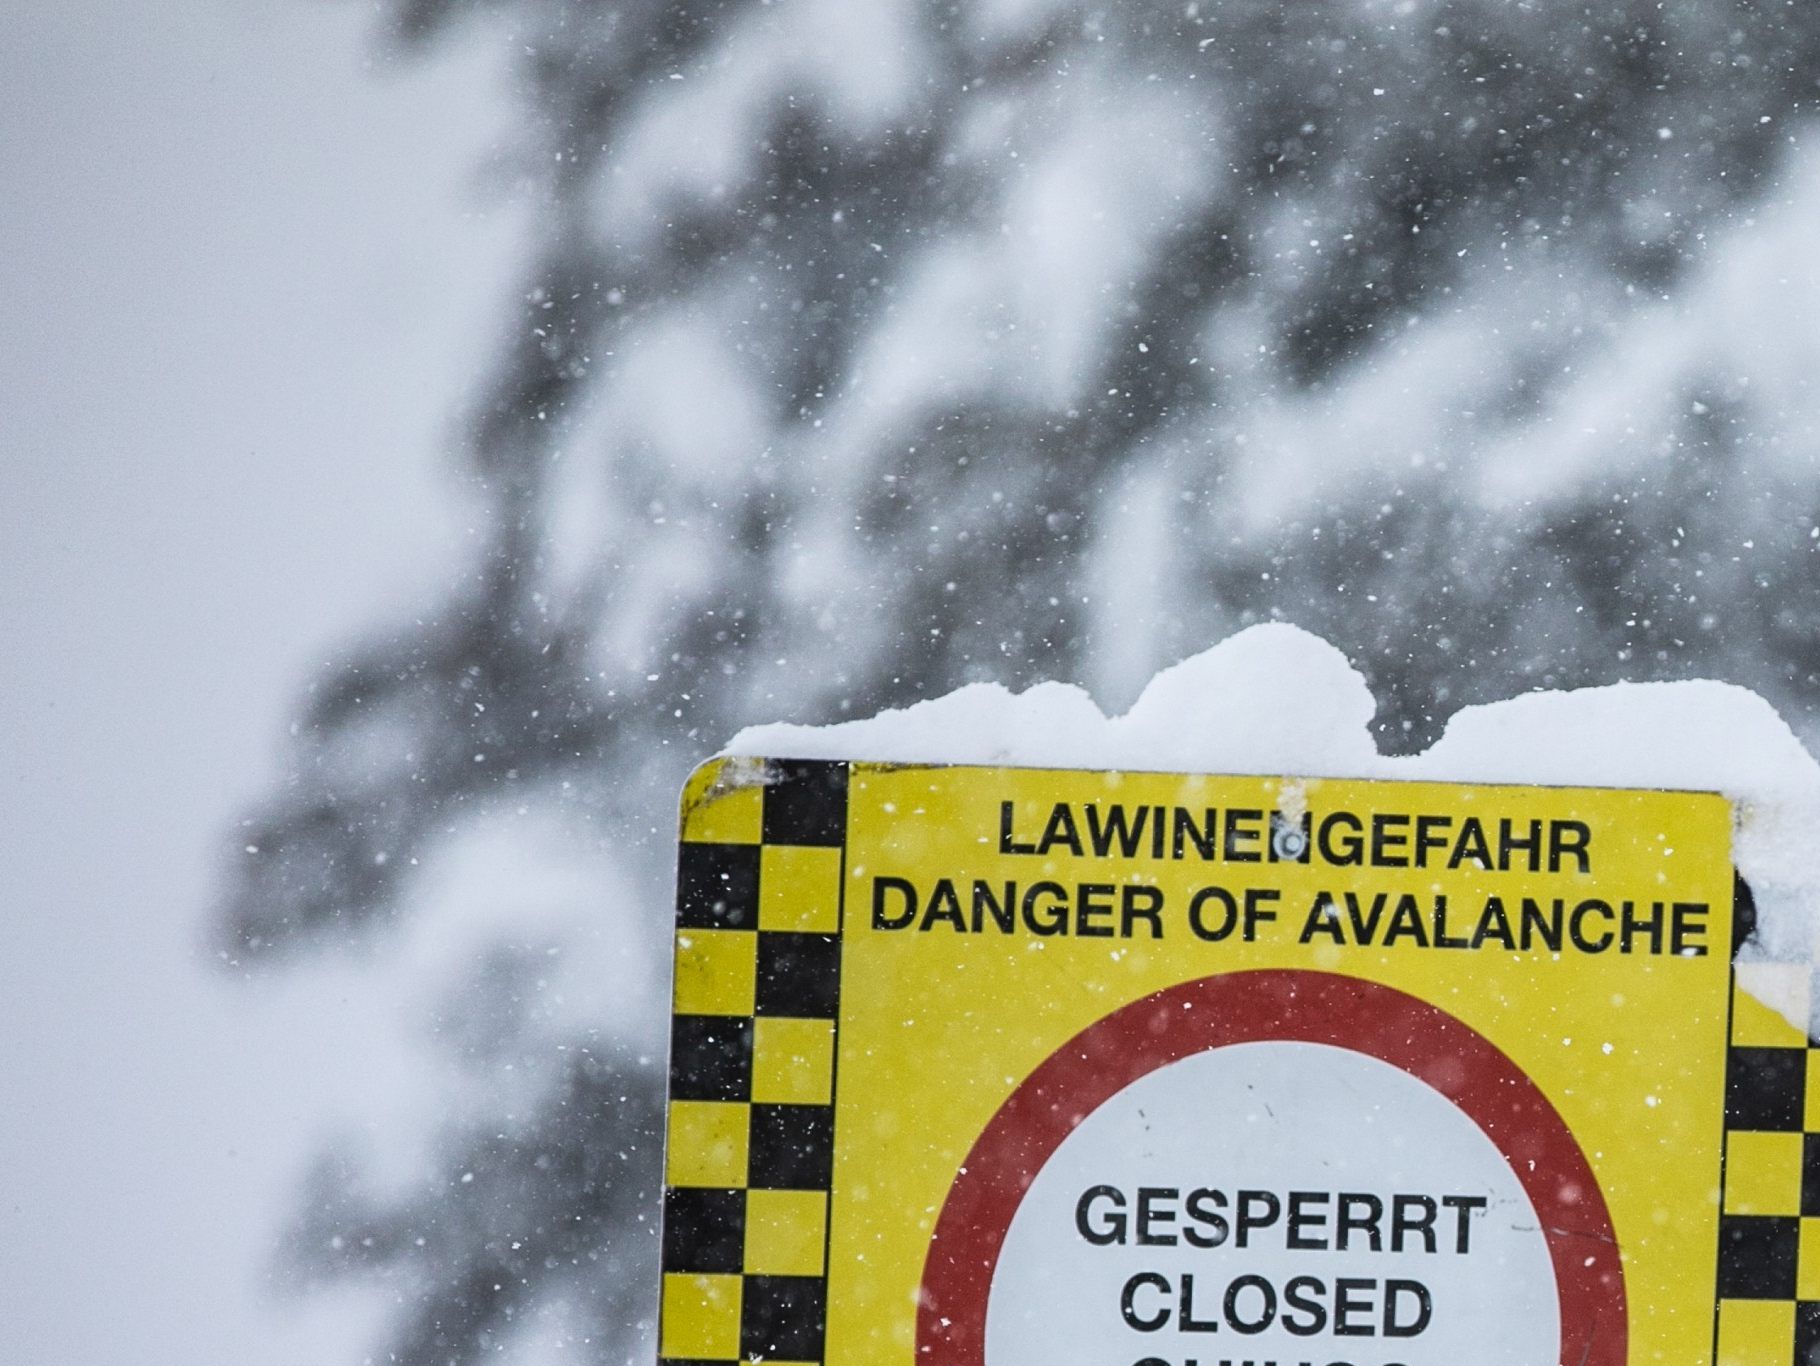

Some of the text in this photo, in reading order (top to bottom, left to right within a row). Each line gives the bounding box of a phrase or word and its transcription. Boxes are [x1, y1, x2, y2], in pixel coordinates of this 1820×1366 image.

[871, 876, 1710, 956] DANGER OF AVALANCHE
[1075, 1184, 1488, 1254] GESPERRT
[1120, 1271, 1433, 1338] CLOSED
